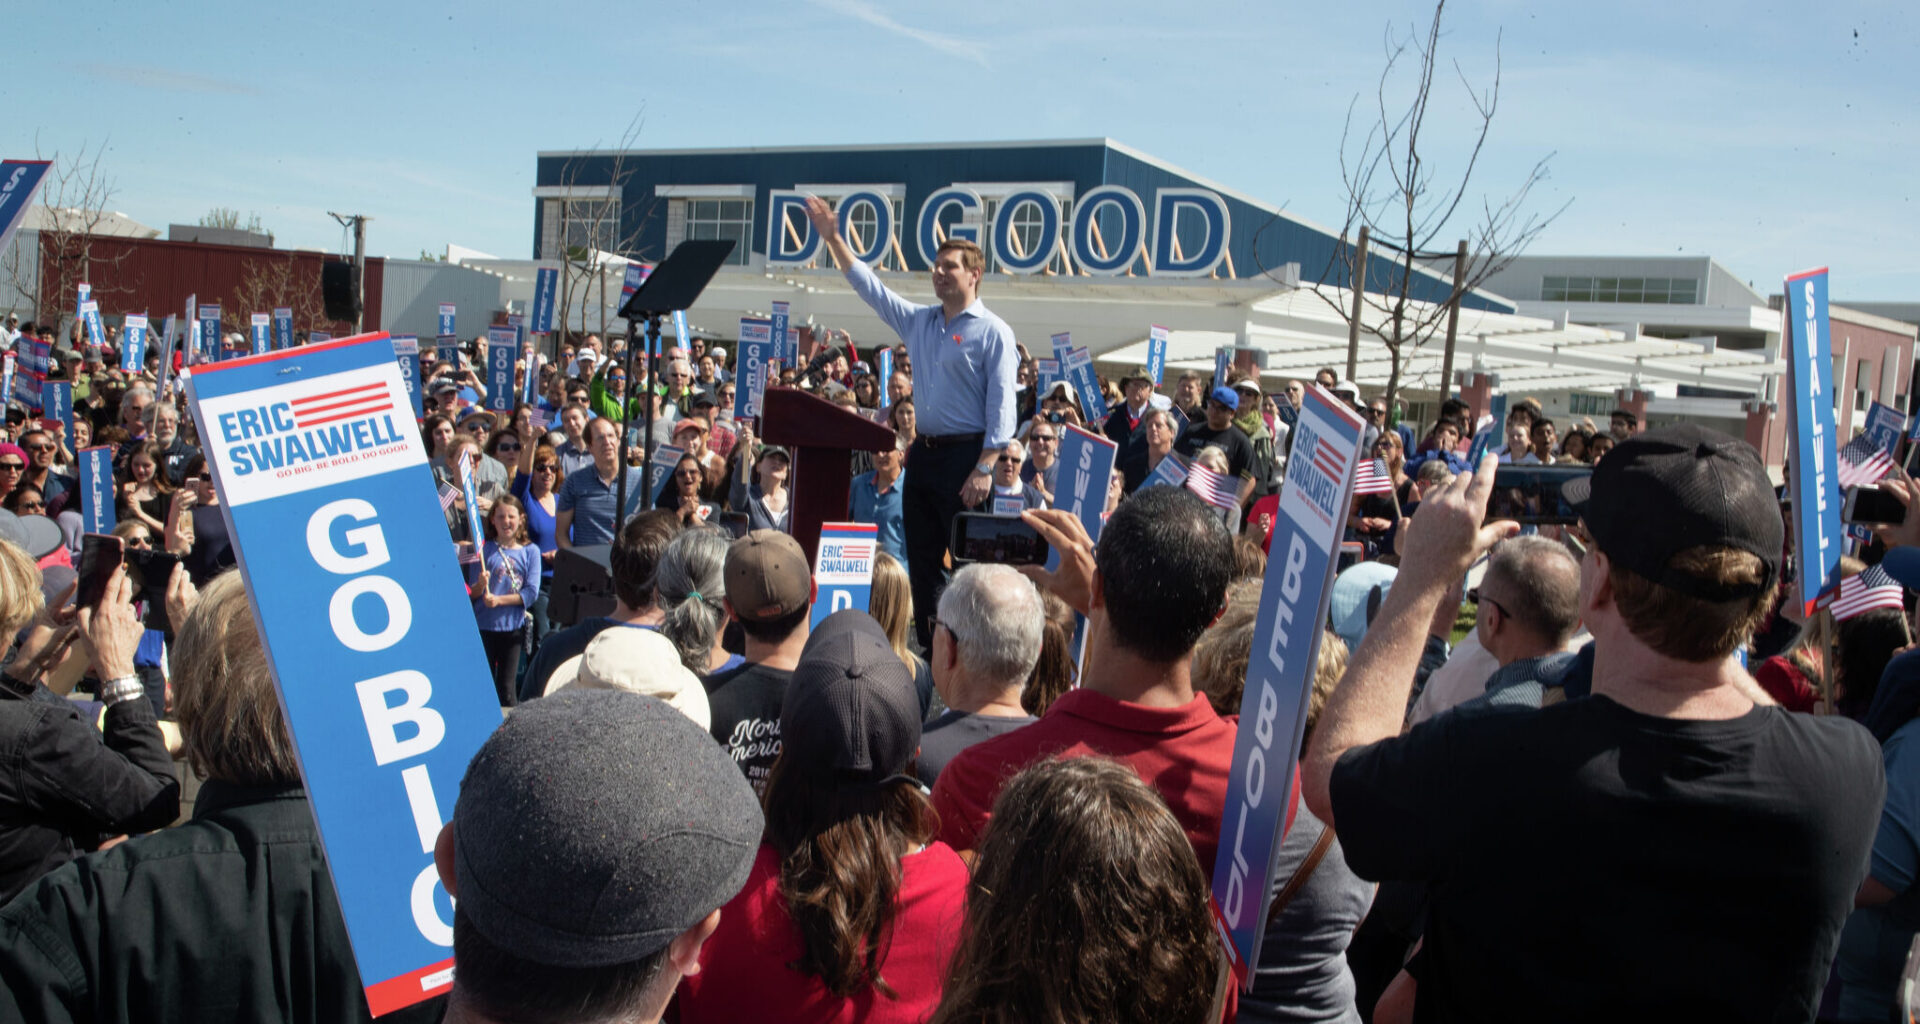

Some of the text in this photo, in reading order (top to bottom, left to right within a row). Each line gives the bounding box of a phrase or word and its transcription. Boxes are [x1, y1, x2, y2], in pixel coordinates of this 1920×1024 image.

[765, 184, 1232, 278] DO GOOD
[127, 327, 140, 371] GO BIG
[205, 320, 215, 336] GO
[494, 347, 508, 410] GO BIG
[746, 344, 761, 371] GO
[218, 401, 294, 444] ERIC
[229, 414, 405, 477] SWALWELL
[1296, 421, 1320, 461] ERIC
[1804, 280, 1831, 588] SWALWELL
[276, 469, 293, 479] GO
[294, 464, 315, 475] BIG.
[316, 461, 330, 471] BE
[331, 454, 361, 467] BOLD.
[361, 450, 378, 461] DO
[1071, 440, 1094, 522] SWA
[1289, 452, 1338, 518] SWALWELL
[305, 497, 413, 653] GO
[820, 559, 869, 573] SWALWELL
[822, 545, 843, 558] ERIC
[1268, 530, 1308, 673] BE
[722, 738, 782, 762] meric
[1222, 677, 1279, 930] BOLD
